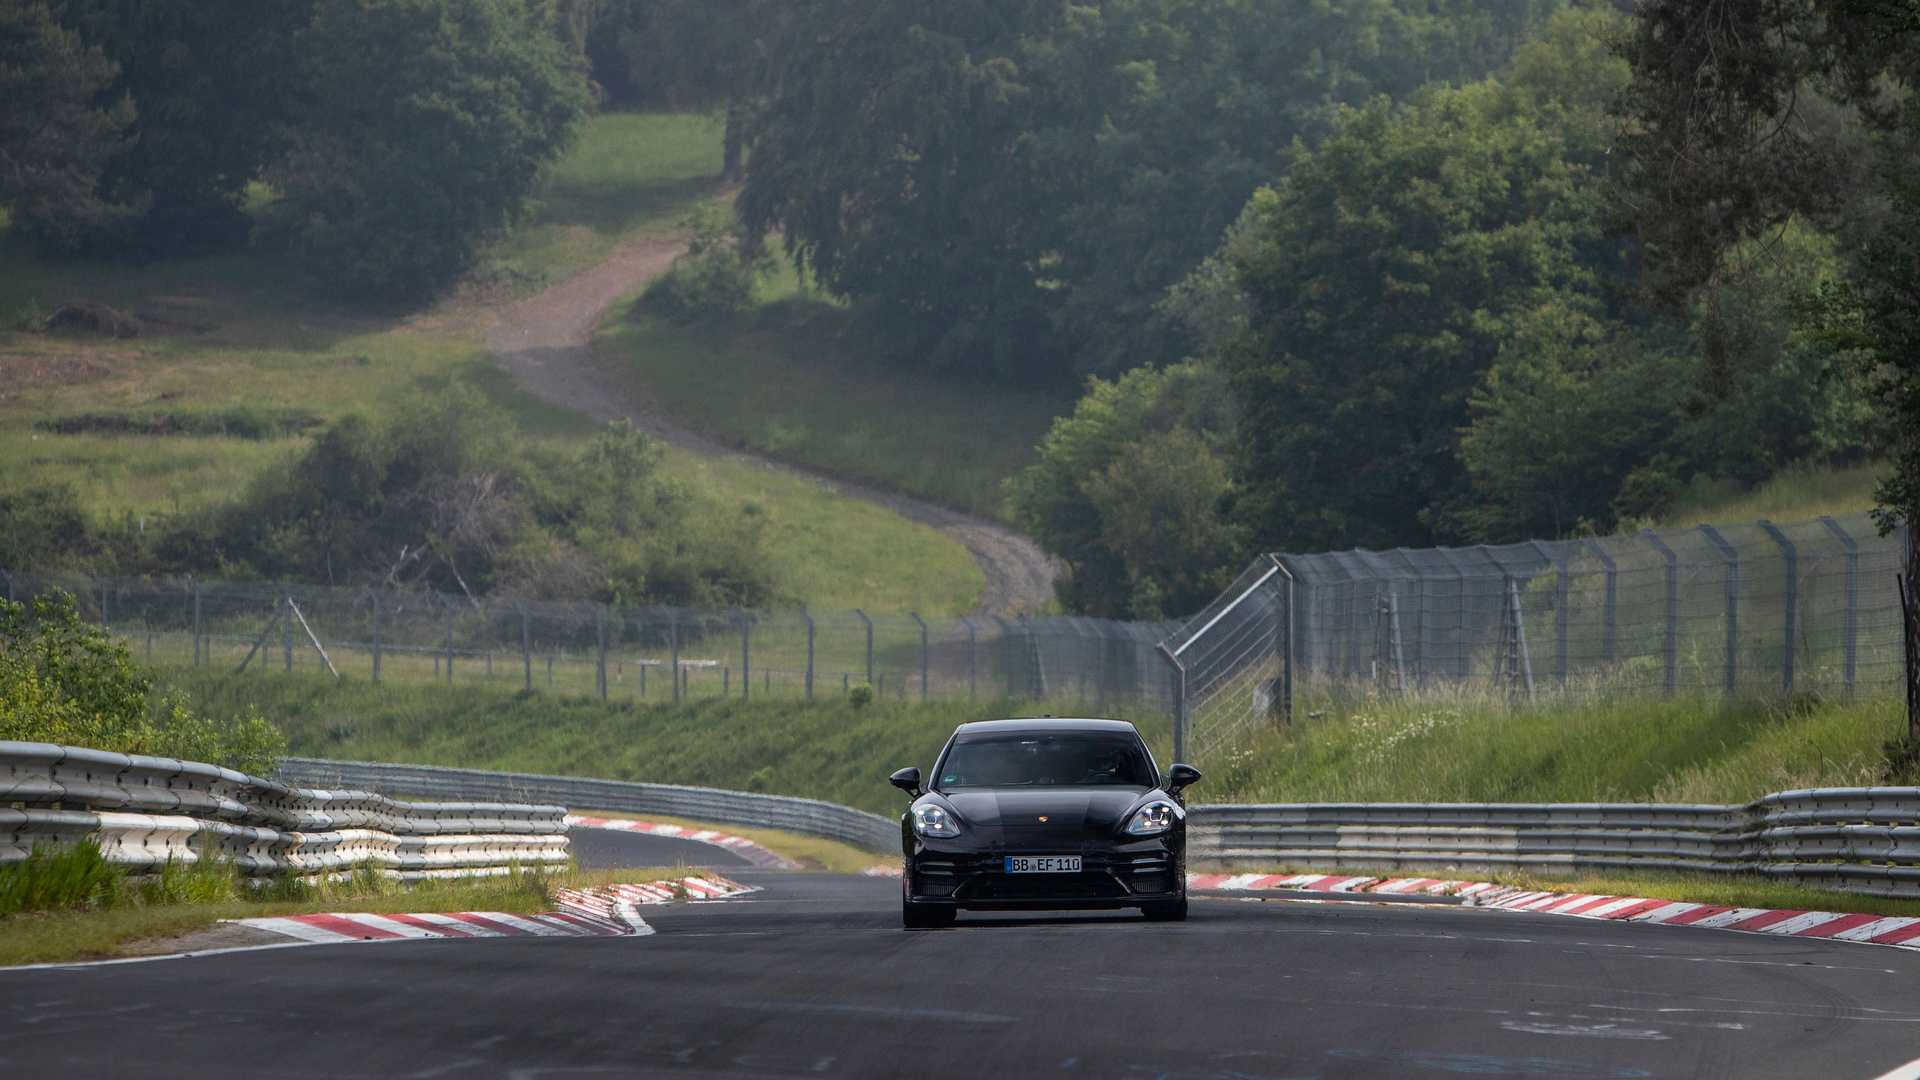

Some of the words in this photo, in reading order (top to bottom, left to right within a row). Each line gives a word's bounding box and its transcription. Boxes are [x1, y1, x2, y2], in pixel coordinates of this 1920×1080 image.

[1012, 858, 1029, 872] BB
[1037, 858, 1054, 871] EF
[1056, 858, 1080, 871] 110
